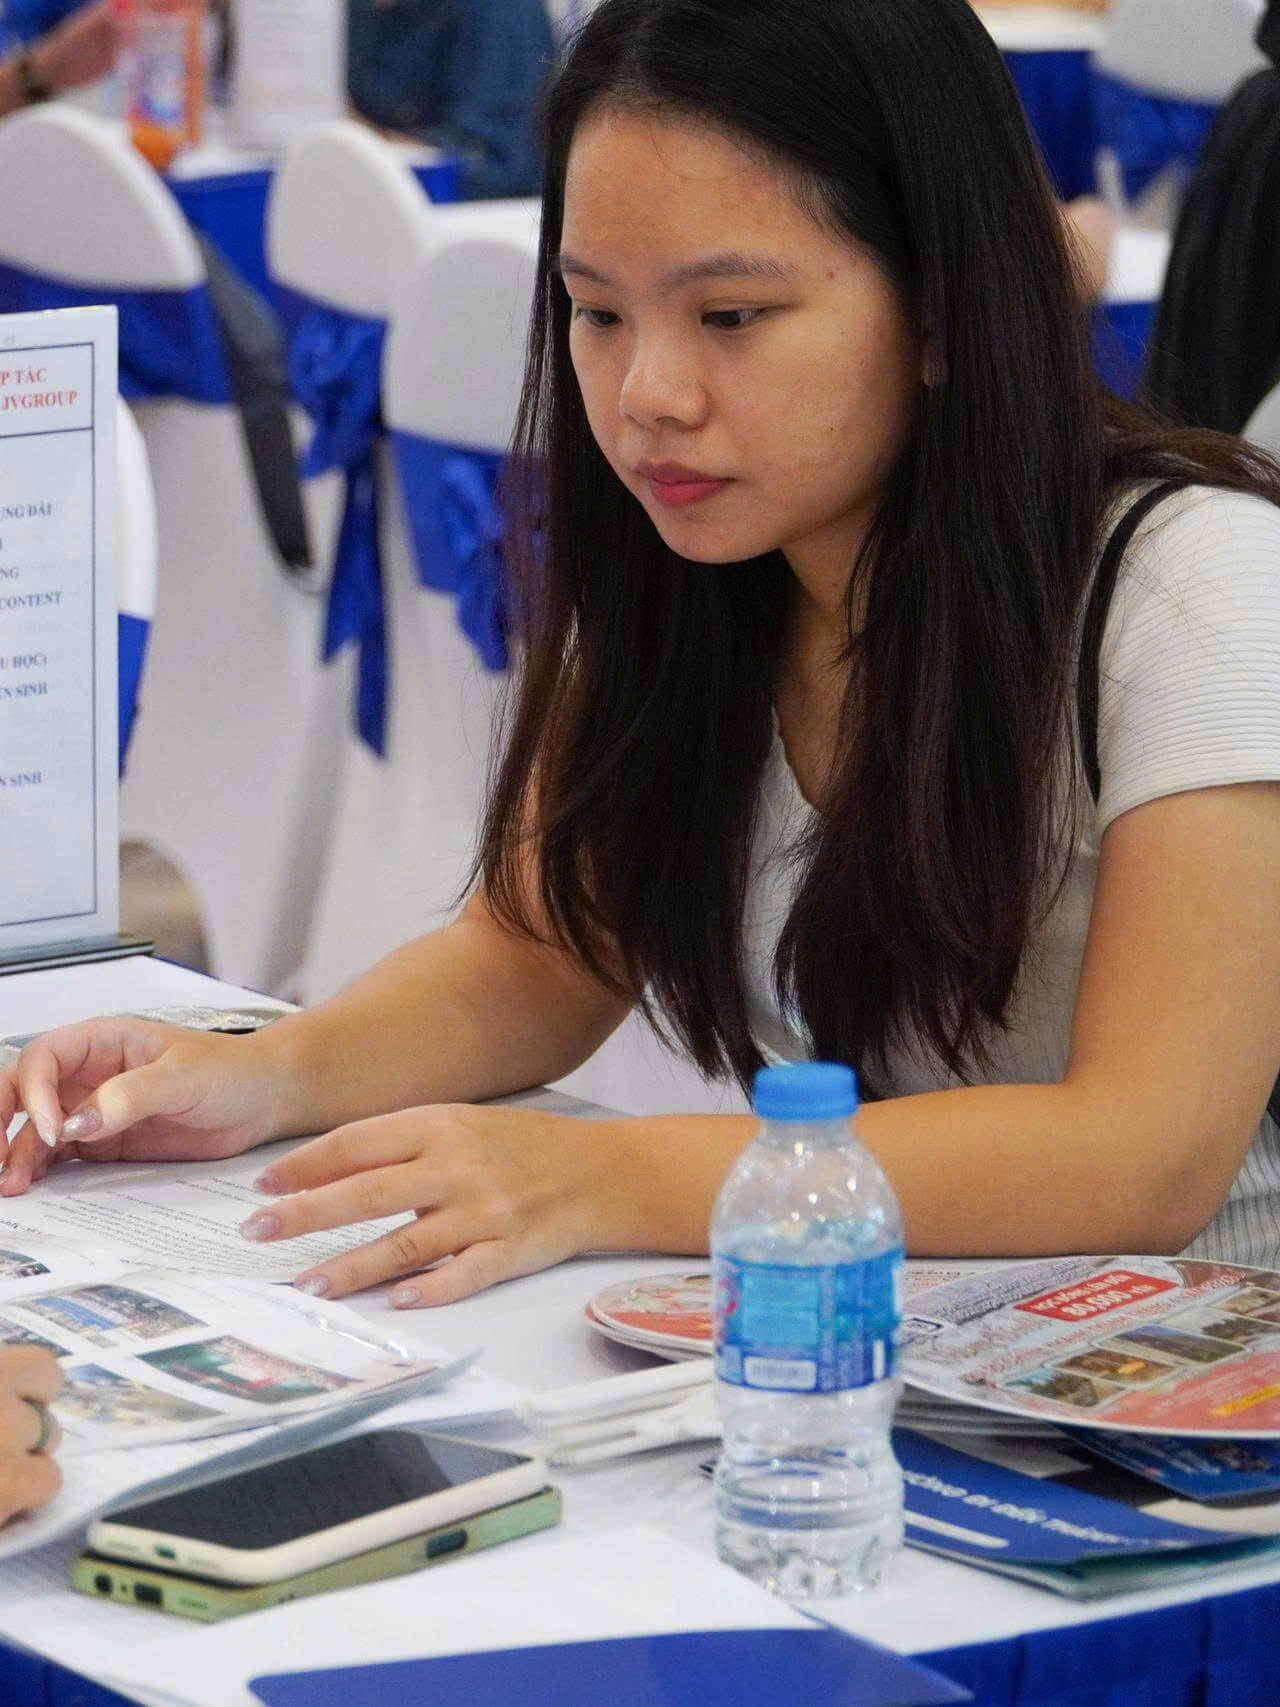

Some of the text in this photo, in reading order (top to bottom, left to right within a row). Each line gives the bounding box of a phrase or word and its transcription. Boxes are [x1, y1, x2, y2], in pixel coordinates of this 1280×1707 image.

[14, 366, 46, 384] TÁC
[1, 389, 77, 410] JVGROUP
[14, 681, 47, 697] SINH
[9, 771, 42, 786] SINH
